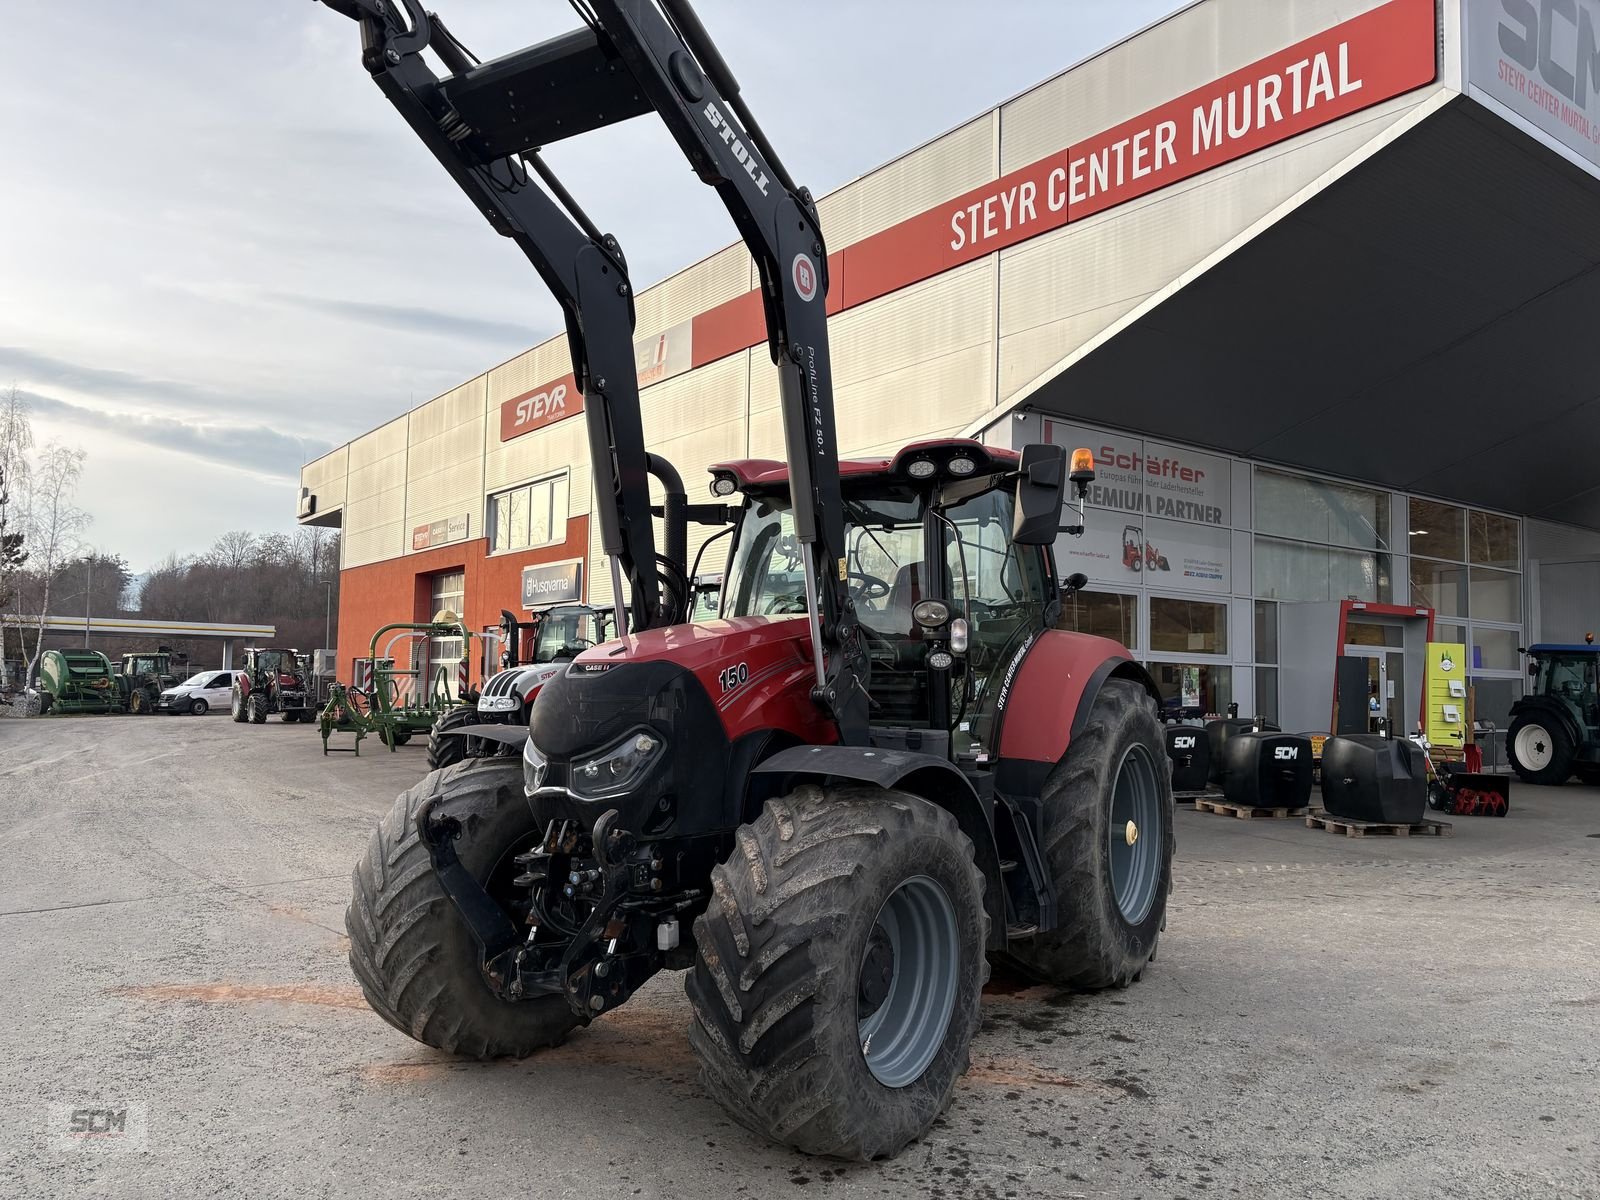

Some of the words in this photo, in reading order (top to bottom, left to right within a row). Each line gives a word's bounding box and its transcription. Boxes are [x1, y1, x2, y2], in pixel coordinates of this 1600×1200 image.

[1498, 59, 1526, 94] STEYR
[1527, 80, 1560, 119] CENTER
[1561, 103, 1591, 140] MURTAL
[703, 102, 771, 197] STOLL
[950, 181, 1036, 252] STEYR
[1047, 121, 1177, 213] CENTER
[1191, 42, 1363, 156] MURTAL
[807, 346, 818, 404] ProfiLine
[514, 384, 567, 428] STEYR
[814, 407, 822, 425] FZ
[816, 429, 825, 455] 50.1
[1093, 446, 1205, 483] Schäffer
[1100, 469, 1126, 483] Europas
[1161, 480, 1204, 497] Laderhersteller
[1156, 496, 1222, 525] PARTNER
[449, 521, 465, 533] Service
[532, 578, 568, 595] Husqvarna
[719, 663, 749, 693] 150
[997, 686, 1008, 711] STEYR
[1004, 660, 1017, 688] CENTER
[1174, 736, 1196, 749] SCM
[1274, 746, 1298, 760] SCM
